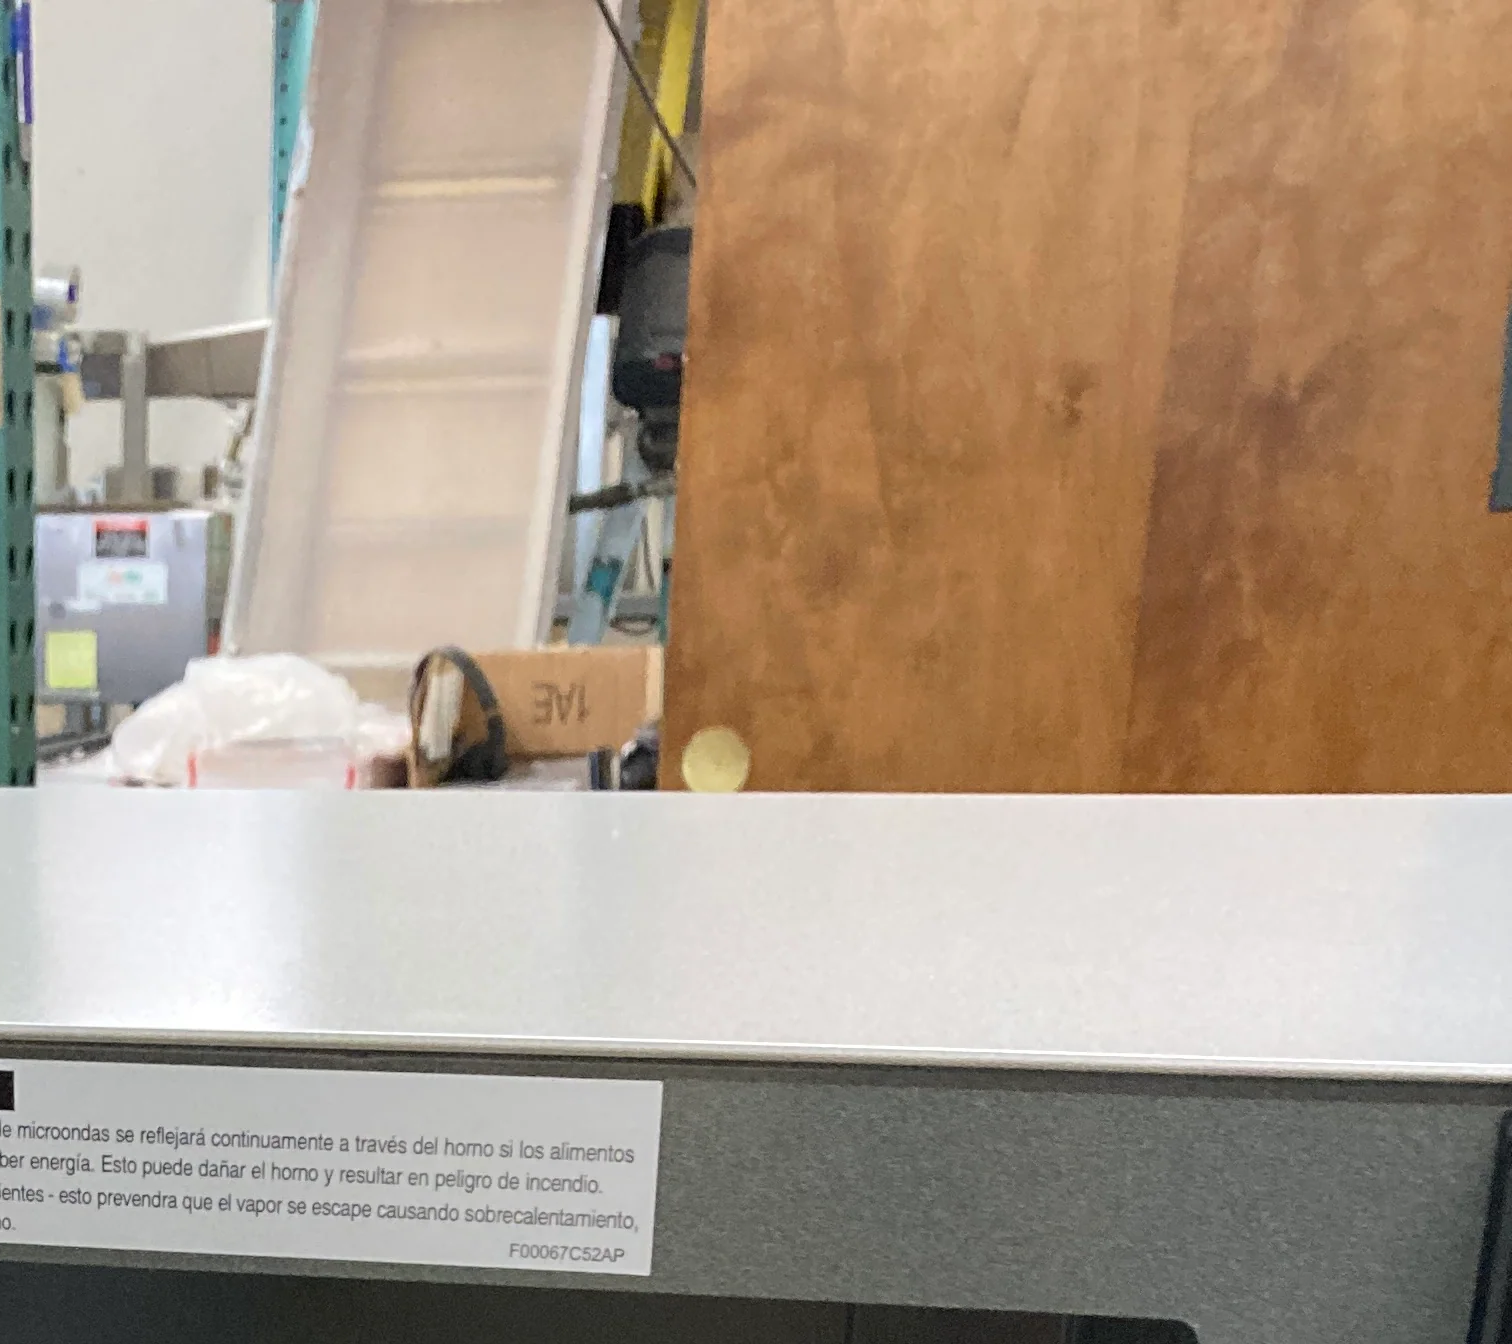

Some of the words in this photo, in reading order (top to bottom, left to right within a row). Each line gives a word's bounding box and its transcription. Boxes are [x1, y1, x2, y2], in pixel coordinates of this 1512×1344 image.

[17, 1120, 110, 1142] microondas
[116, 1129, 134, 1143] se
[140, 1126, 205, 1150] reflejará
[211, 1131, 333, 1151] continuamente
[340, 1138, 349, 1152] a
[355, 1135, 407, 1154] través
[413, 1136, 438, 1155] del
[444, 1138, 494, 1158] horno
[499, 1143, 513, 1158] si
[520, 1140, 544, 1160] los
[550, 1143, 634, 1163] alimentos
[30, 1153, 94, 1176] energía.
[102, 1154, 137, 1175] Esto
[142, 1158, 193, 1179] puede
[198, 1159, 246, 1179] dañar
[251, 1161, 265, 1180] el
[271, 1161, 318, 1182] horno
[324, 1168, 334, 1187] y
[340, 1166, 403, 1185] resultar
[408, 1172, 429, 1186] en
[435, 1170, 492, 1194] peligro
[498, 1172, 519, 1190] de
[526, 1175, 602, 1194] incendio.
[59, 1187, 92, 1205] esto
[97, 1190, 177, 1210] prevendra
[182, 1195, 212, 1215] que
[218, 1193, 231, 1211] el
[236, 1198, 283, 1218] vapor
[287, 1200, 306, 1215] se
[312, 1201, 371, 1221] escape
[377, 1204, 459, 1222] causando
[465, 1205, 638, 1232] sobrecalentamiento,
[509, 1243, 625, 1263] F00067C52AP
